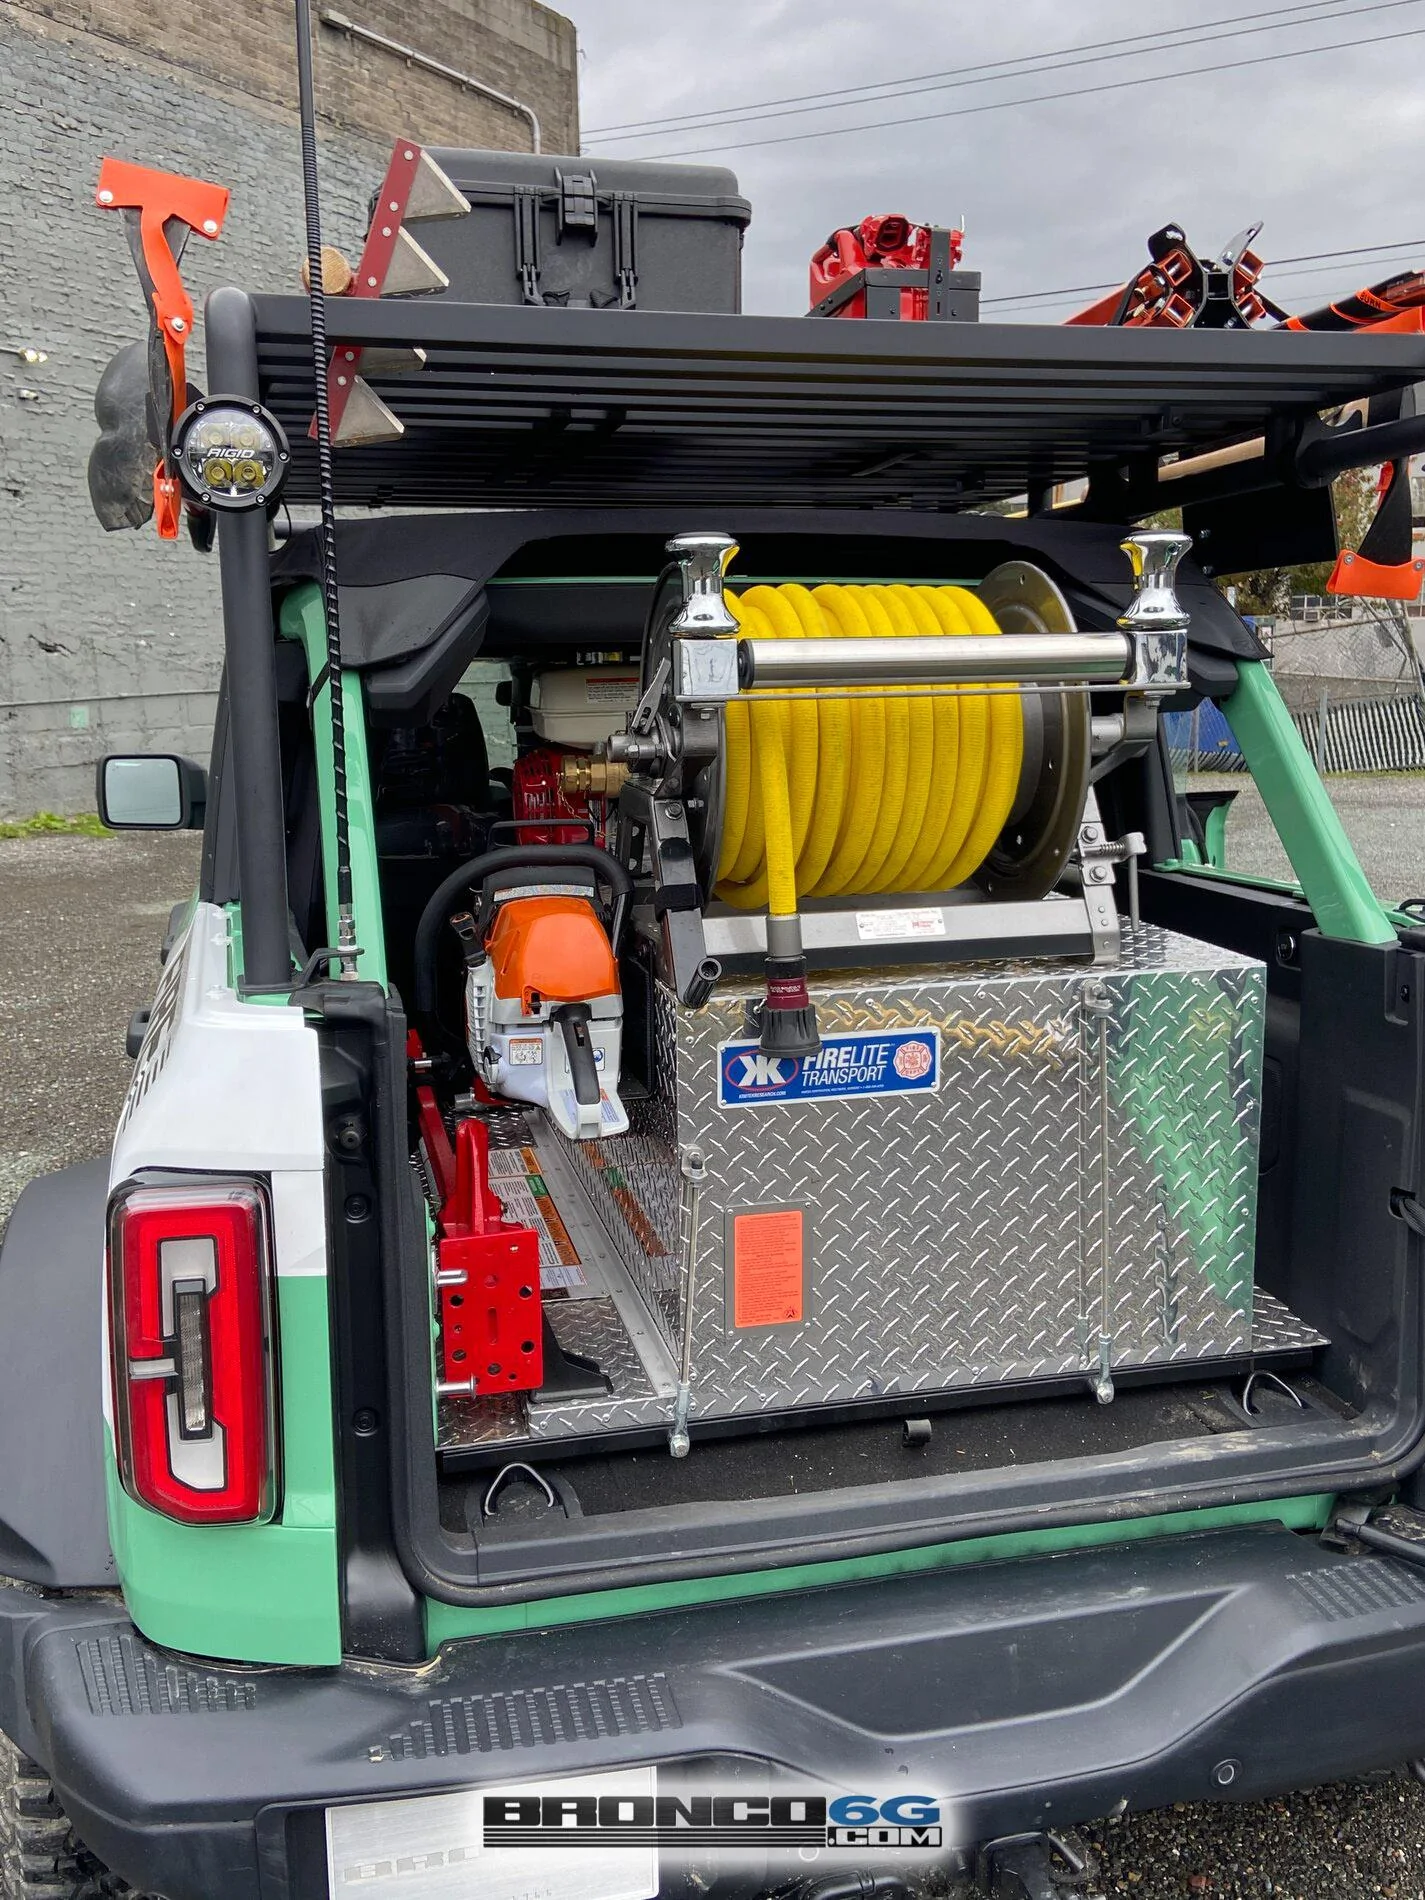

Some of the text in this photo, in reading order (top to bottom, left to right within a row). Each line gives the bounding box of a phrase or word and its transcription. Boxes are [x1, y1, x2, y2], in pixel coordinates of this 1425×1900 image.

[207, 448, 255, 458] RIGID
[802, 1044, 888, 1071] FIRELITE
[801, 1065, 887, 1087] TRANSPORT
